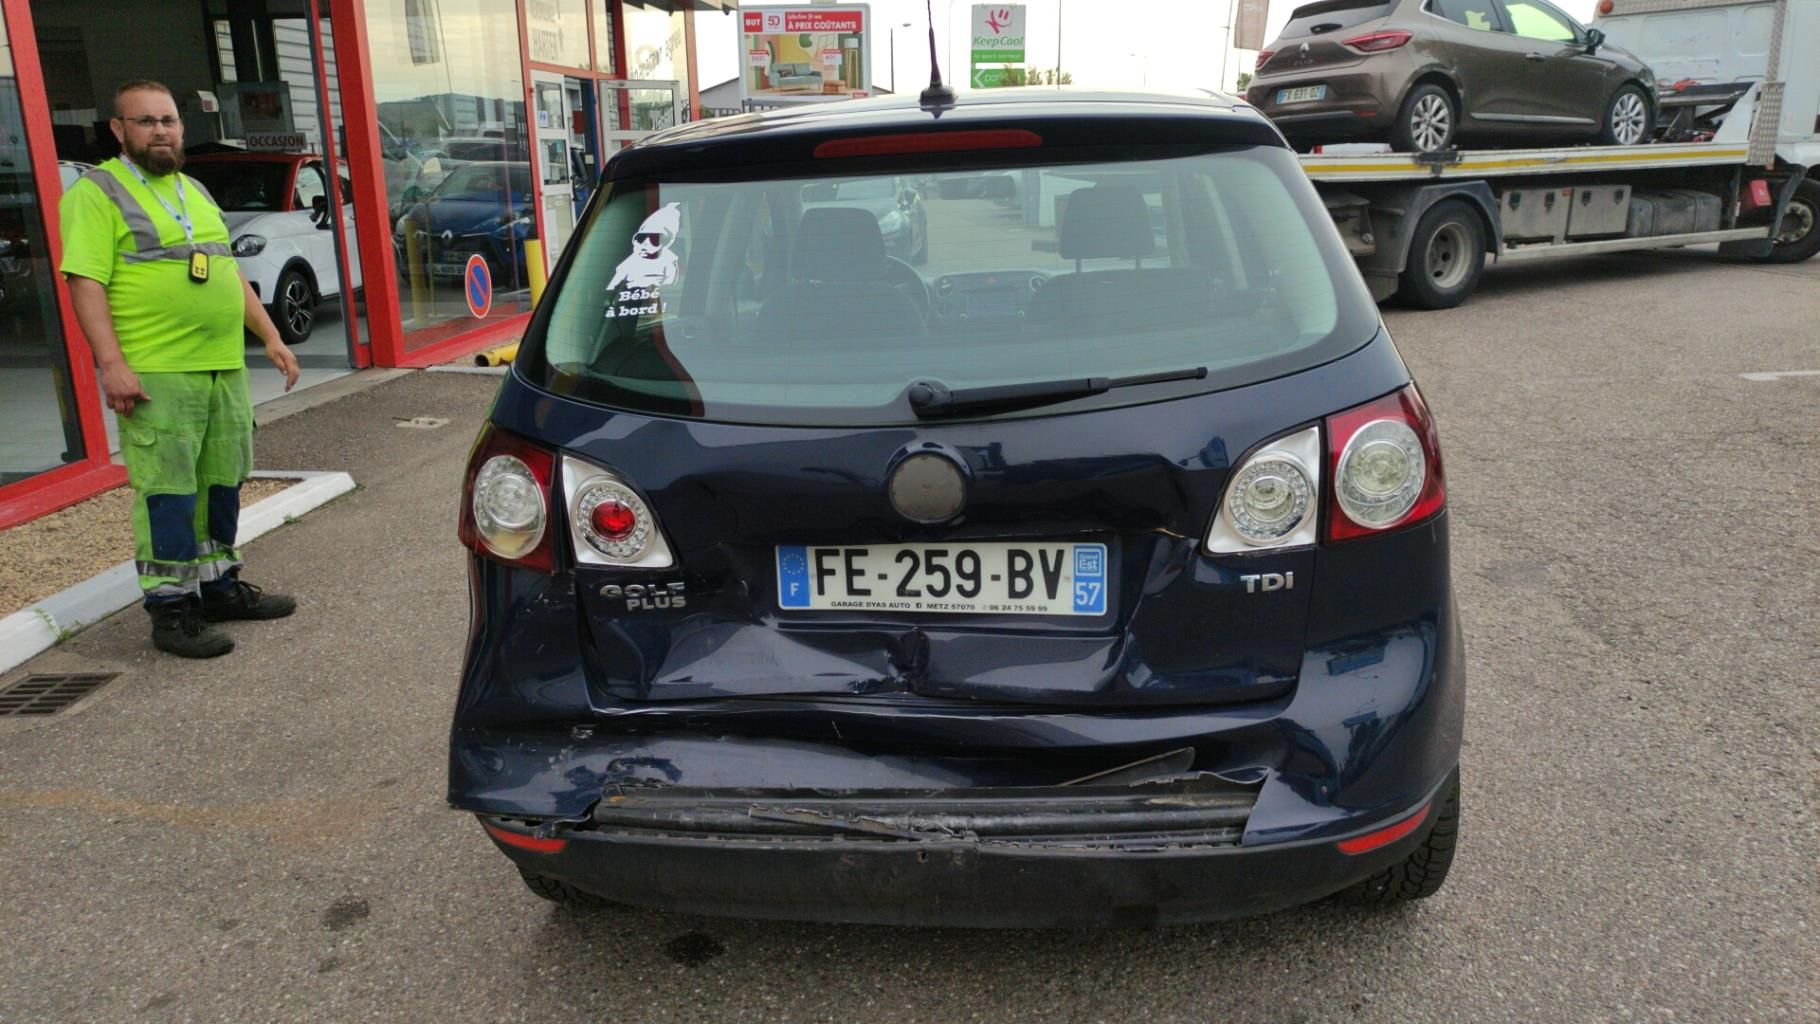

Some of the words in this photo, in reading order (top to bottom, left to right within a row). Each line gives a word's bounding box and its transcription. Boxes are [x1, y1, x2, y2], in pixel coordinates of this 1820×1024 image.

[745, 18, 761, 26] BUT
[788, 20, 795, 29] À
[795, 21, 812, 29] PRIX
[813, 20, 857, 29] COÛTANTS
[249, 135, 305, 147] OCCASION
[618, 288, 660, 302] Bébé
[605, 307, 616, 318] à
[618, 303, 659, 317] bord
[1079, 560, 1098, 570] Est
[814, 548, 1065, 600] FE-259-BV
[789, 582, 799, 596] F
[1075, 582, 1101, 606] 57
[626, 595, 687, 612] PLUS
